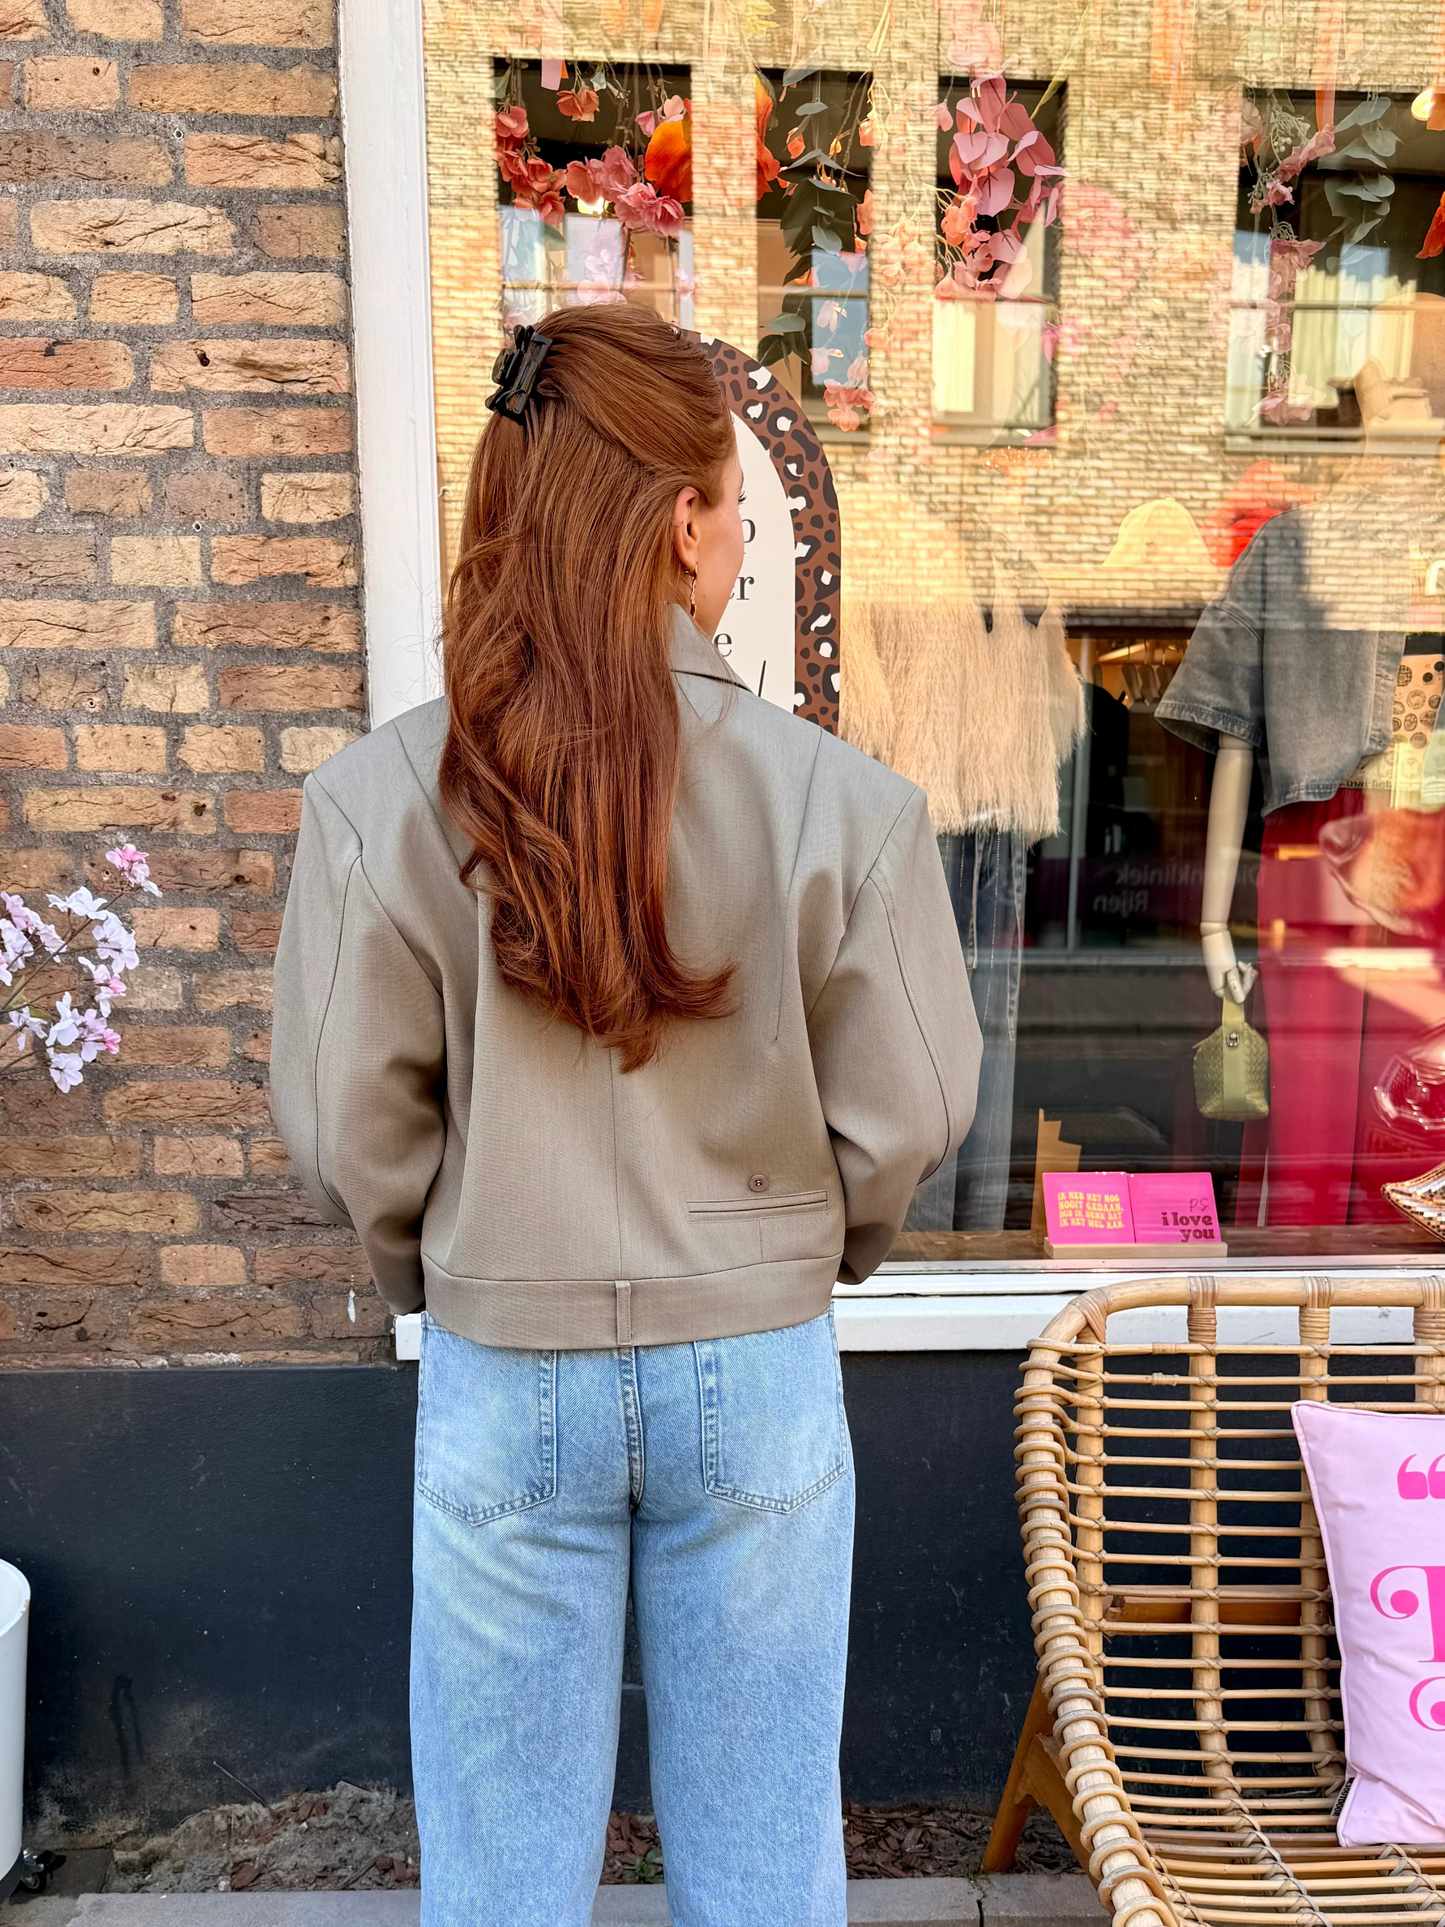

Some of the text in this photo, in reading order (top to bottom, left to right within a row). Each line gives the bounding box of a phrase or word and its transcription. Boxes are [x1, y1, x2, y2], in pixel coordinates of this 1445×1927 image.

[1068, 1191, 1084, 1200] HEB
[1087, 1193, 1101, 1202] HET
[1104, 1194, 1120, 1203] NOG
[1058, 1200, 1083, 1210] NOOIT
[1108, 1211, 1122, 1220] DAT
[1161, 1212, 1213, 1226] i love
[1071, 1218, 1085, 1227] HET
[1180, 1228, 1215, 1243] you
